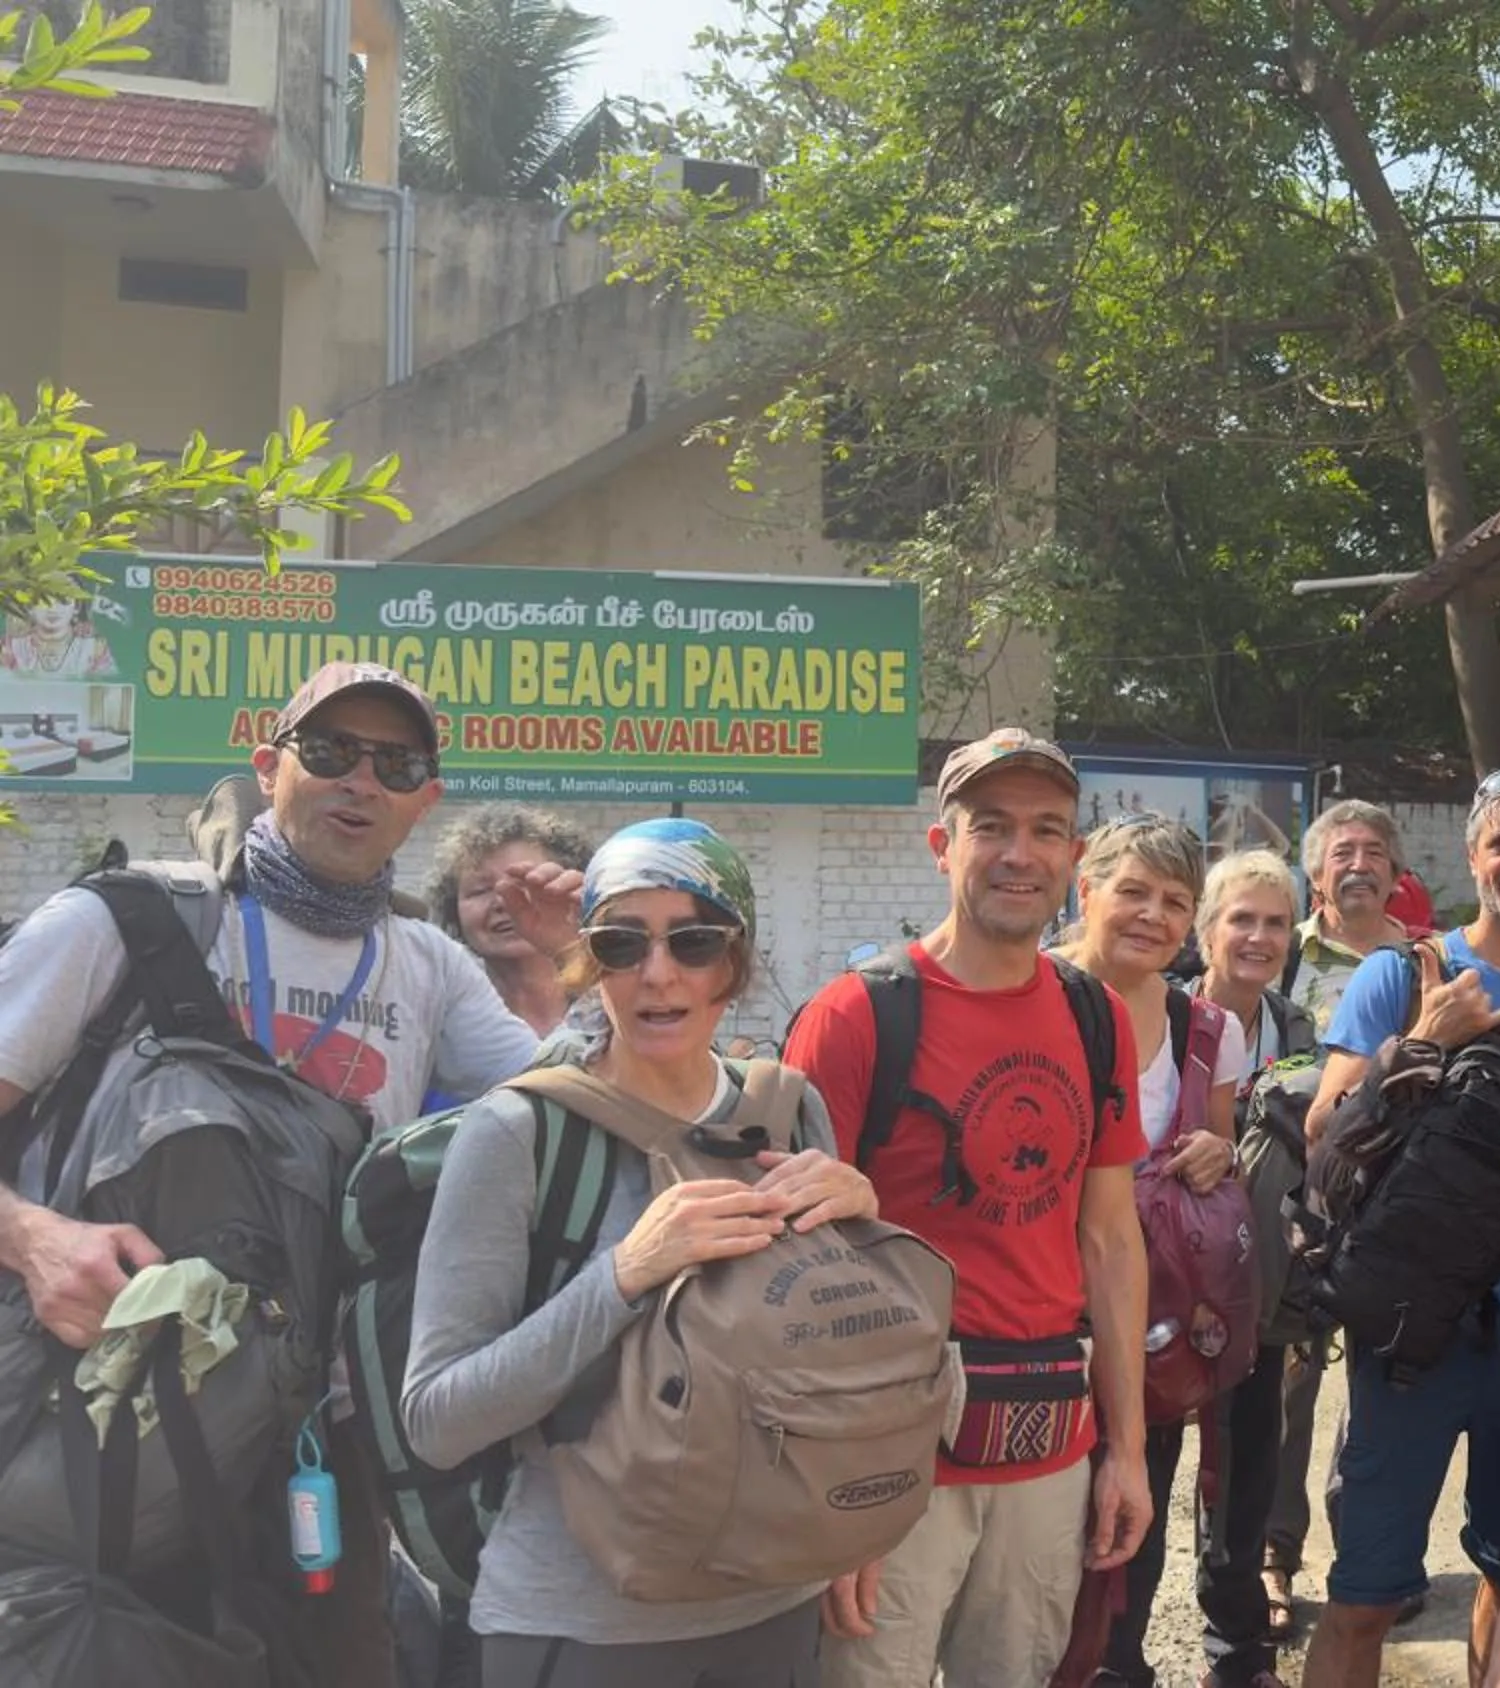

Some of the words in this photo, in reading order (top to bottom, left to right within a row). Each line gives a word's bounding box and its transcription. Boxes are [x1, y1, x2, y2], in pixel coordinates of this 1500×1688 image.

[154, 566, 336, 596] 9940624526
[154, 592, 335, 623] 9840383570
[445, 597, 588, 631] முருகன்
[597, 596, 645, 629] பீச்
[652, 600, 815, 635] பேரடைஸ்
[146, 628, 228, 697] SRI
[510, 639, 667, 708] BEACH
[684, 645, 906, 713] PARADISE
[462, 714, 603, 753] ROOMS
[611, 716, 823, 757] AVAILABLE
[470, 777, 499, 791] Koil
[561, 778, 673, 795] Mamallapuram
